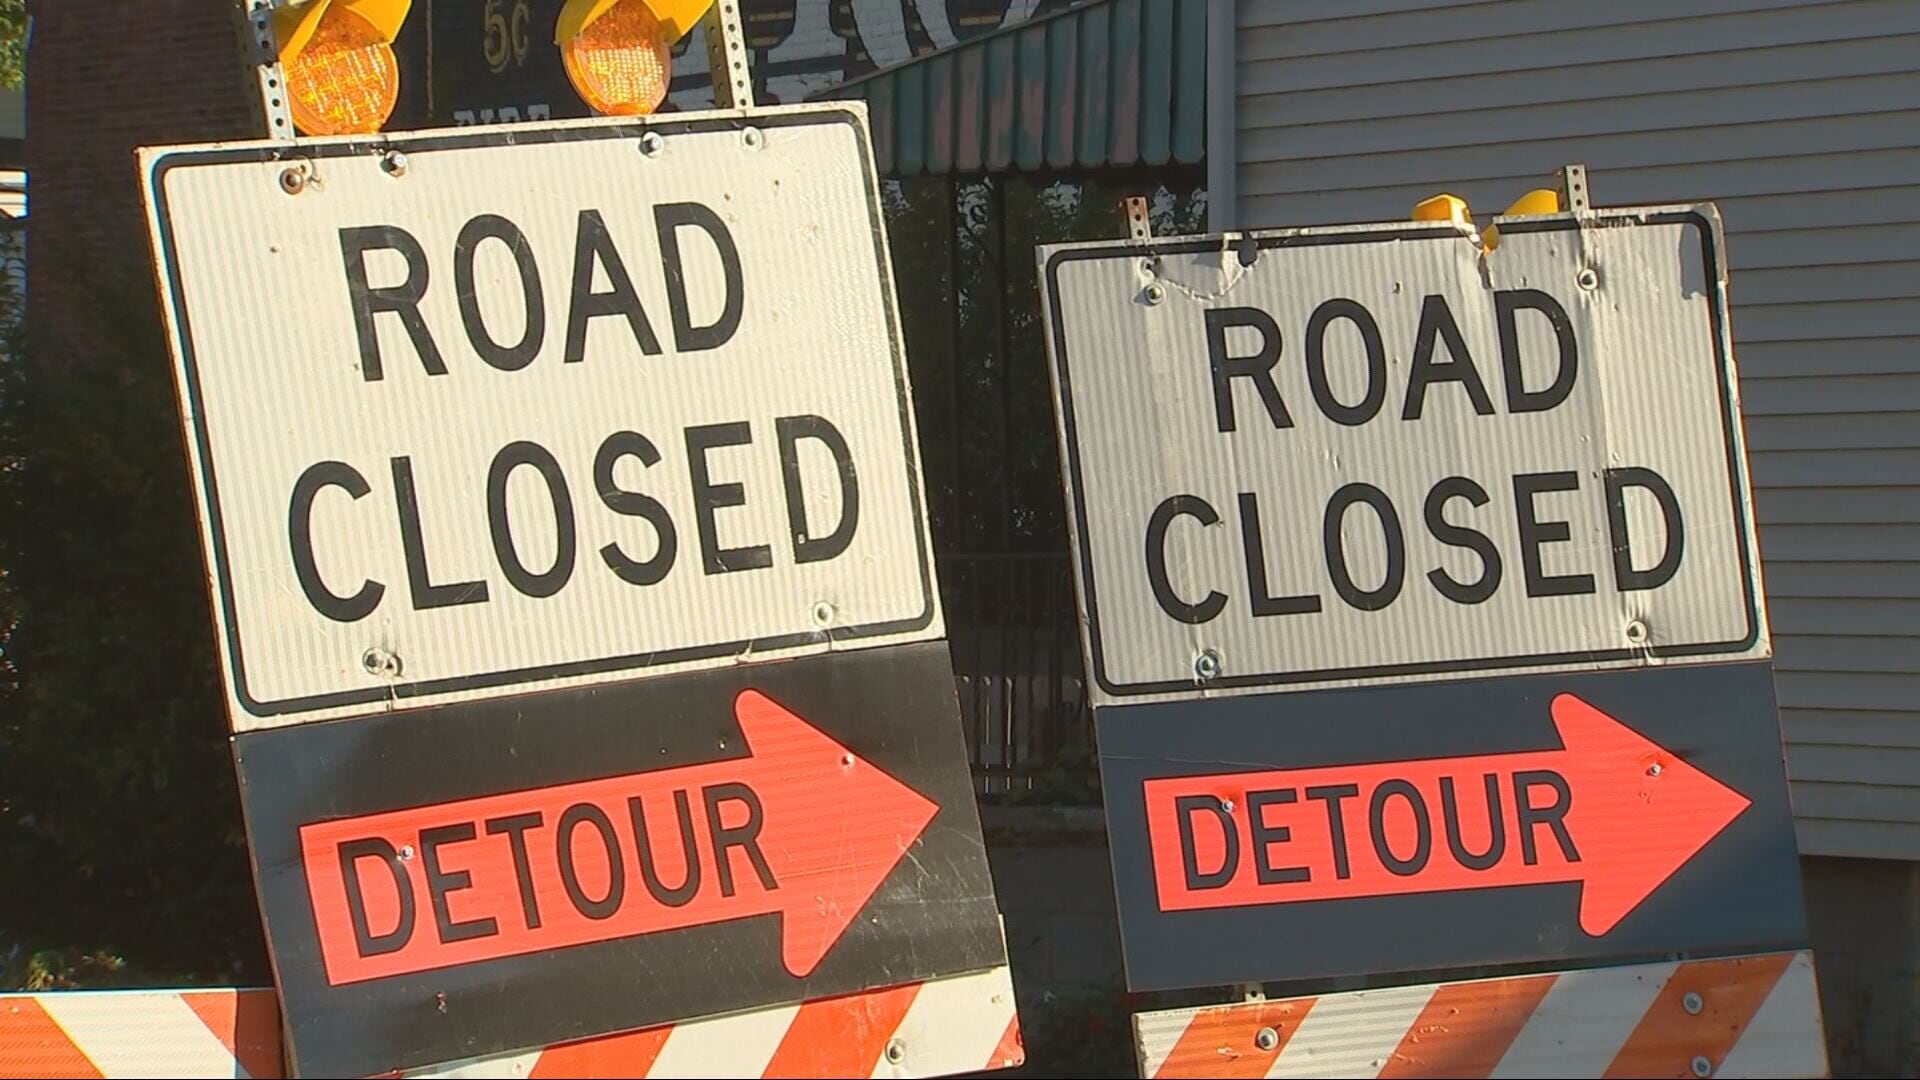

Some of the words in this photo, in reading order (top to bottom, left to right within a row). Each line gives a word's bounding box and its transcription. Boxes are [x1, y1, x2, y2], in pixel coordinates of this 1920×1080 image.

[339, 201, 744, 382] ROAD
[1204, 288, 1578, 433] ROAD
[289, 414, 860, 623] CLOSED
[1145, 466, 1685, 625] CLOSED
[336, 782, 779, 958] DETOUR
[1175, 769, 1583, 891] DETOUR
